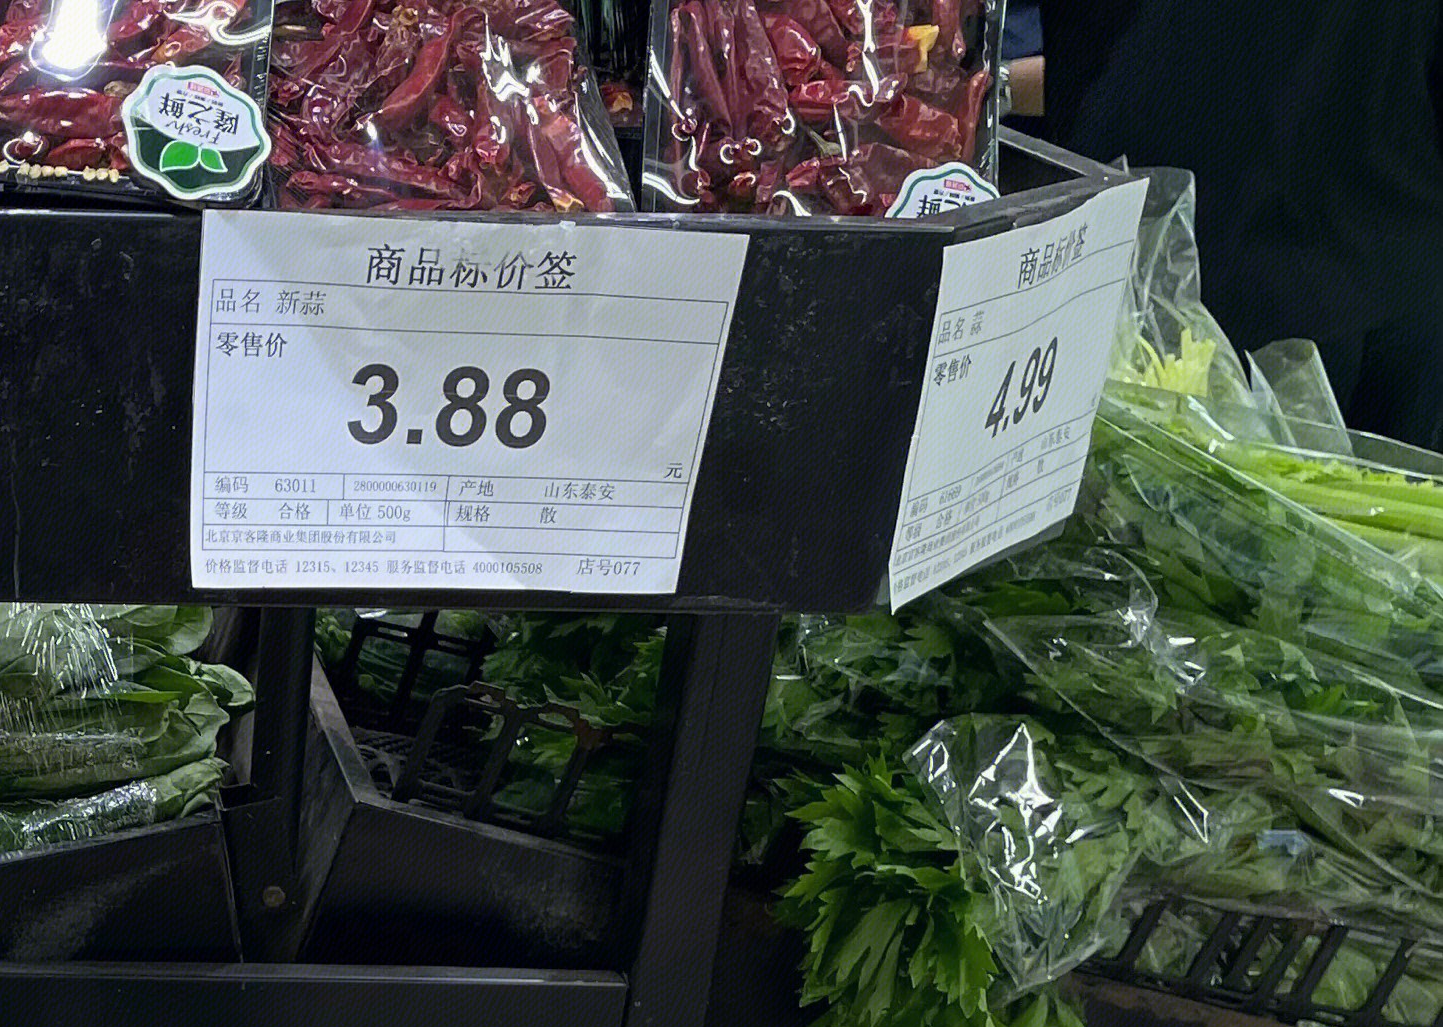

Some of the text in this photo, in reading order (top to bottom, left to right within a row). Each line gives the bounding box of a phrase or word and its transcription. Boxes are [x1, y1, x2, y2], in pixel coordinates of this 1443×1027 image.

[367, 243, 577, 291] 商品标价签
[215, 289, 327, 316] 品名 新蒜
[938, 316, 965, 346] 品名
[215, 331, 288, 359] 零售价
[933, 354, 972, 387] 零售价
[985, 336, 1057, 438] 4.99
[347, 363, 551, 449] 3.88
[664, 463, 683, 480] 元
[215, 475, 316, 494] 编码 63011
[458, 479, 615, 501] 产地 山东泰安
[215, 502, 311, 520] 等级 合格
[339, 504, 411, 523] 单位 500g
[455, 505, 557, 525] 规格 散
[205, 529, 396, 545] 北京京客隆商业集团股份有限公司
[205, 558, 288, 575] 价格监督电话
[387, 559, 466, 575] 服务监督电话
[472, 561, 543, 575] 4000105508
[577, 557, 641, 578] 店号077
